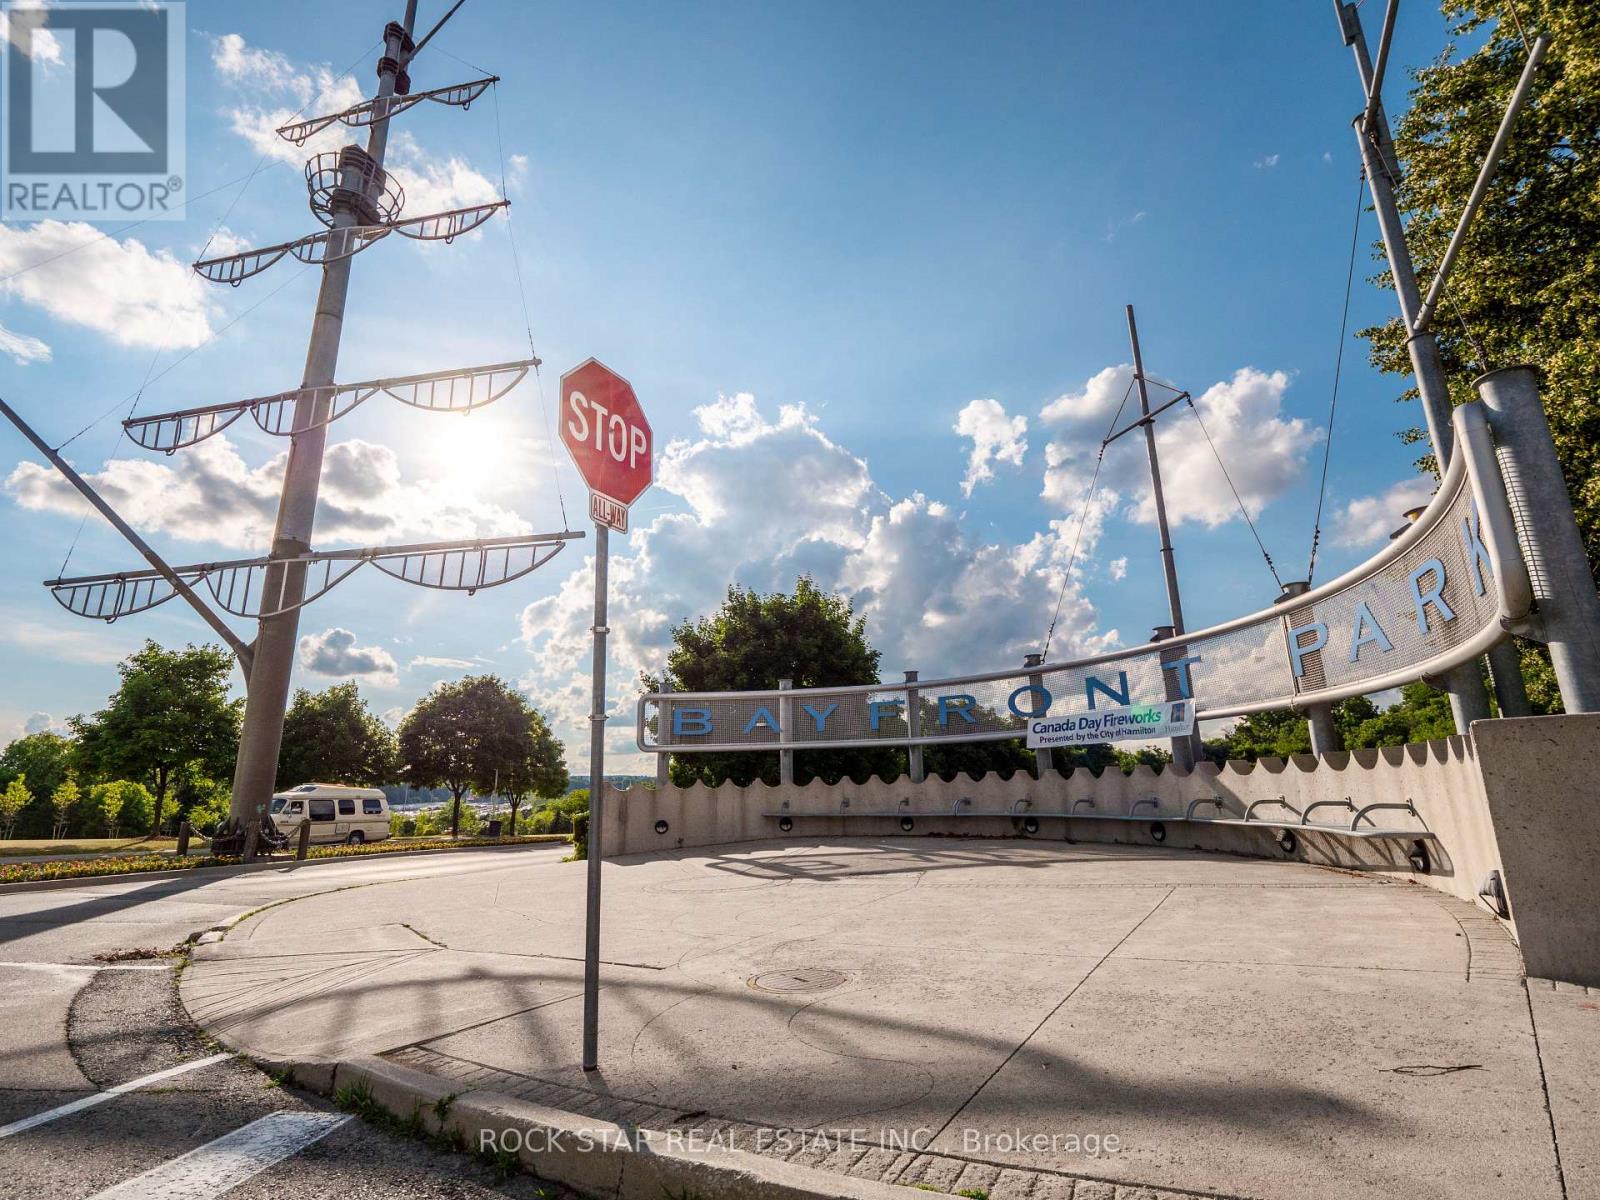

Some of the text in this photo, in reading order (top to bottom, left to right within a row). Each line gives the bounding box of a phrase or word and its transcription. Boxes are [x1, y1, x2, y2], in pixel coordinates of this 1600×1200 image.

[568, 391, 647, 469] STOP
[593, 496, 627, 529] ALL-WAY
[672, 498, 1494, 736] BAYFRONT PARK
[1032, 708, 1162, 734] Canada Day Fireworks
[1039, 733, 1074, 744] Presented
[1076, 732, 1086, 742] by
[1087, 731, 1099, 741] the
[1100, 730, 1114, 740] City
[1121, 726, 1156, 737] Hamilton
